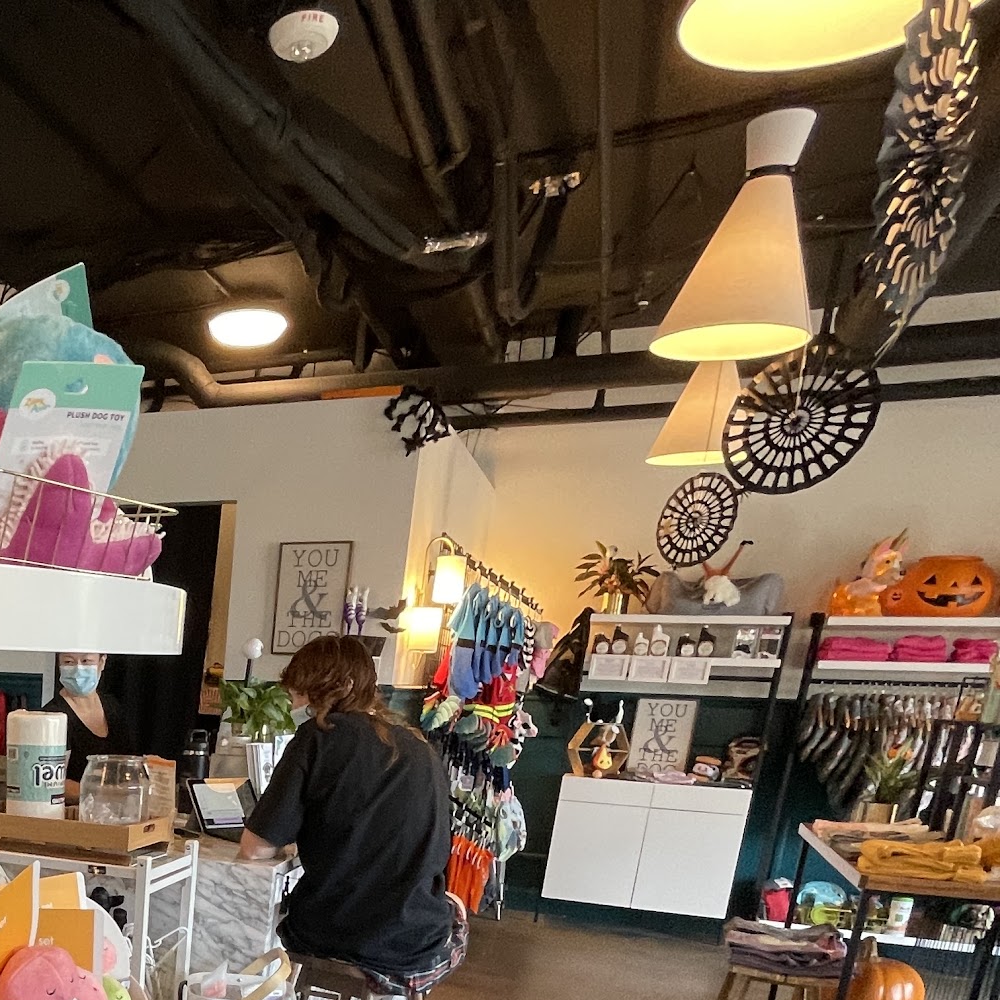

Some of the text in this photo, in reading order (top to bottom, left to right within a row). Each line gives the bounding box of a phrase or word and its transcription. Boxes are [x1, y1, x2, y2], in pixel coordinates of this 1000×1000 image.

[301, 12, 325, 23] FIRE
[66, 411, 126, 421] PLUSH DOG TOY
[293, 548, 340, 568] YOU
[296, 569, 328, 588] ME
[289, 579, 329, 619] &
[286, 610, 332, 628] THE
[647, 702, 688, 718] YOU
[648, 717, 678, 733] ME
[642, 724, 676, 754] &
[638, 747, 679, 763] THE
[38, 936, 55, 946] set
